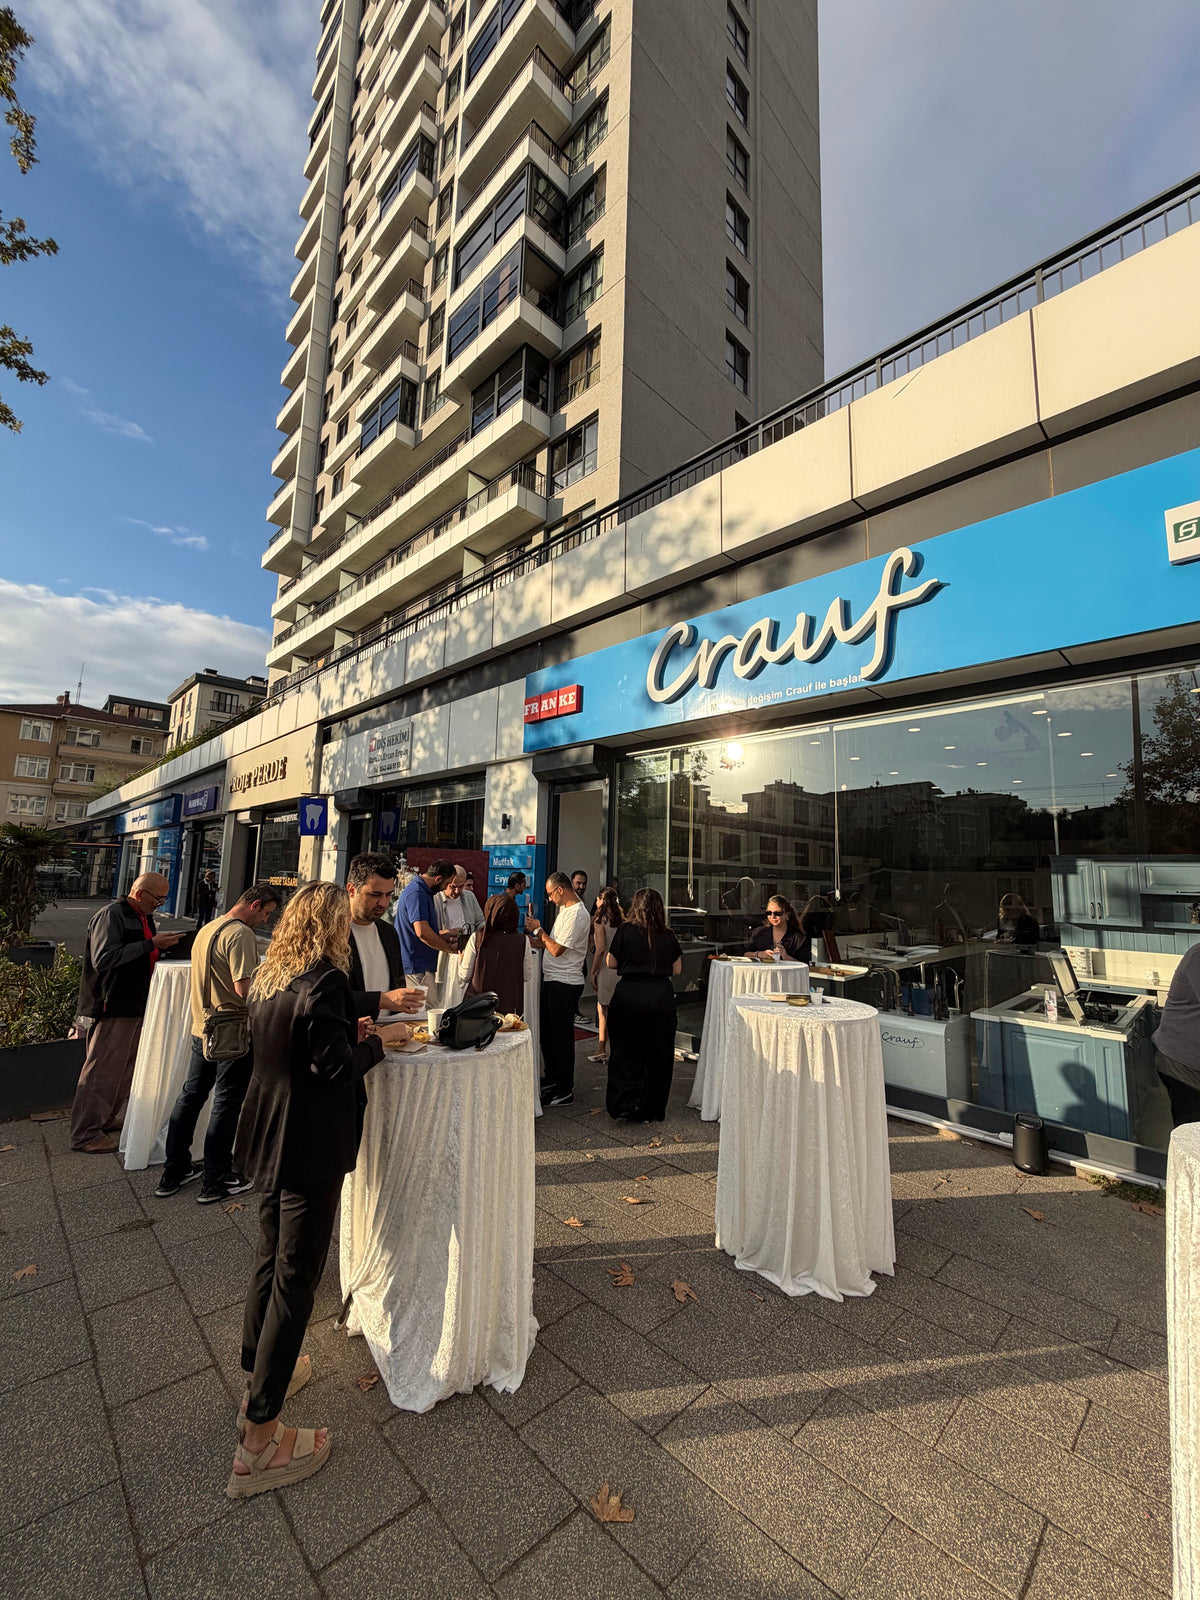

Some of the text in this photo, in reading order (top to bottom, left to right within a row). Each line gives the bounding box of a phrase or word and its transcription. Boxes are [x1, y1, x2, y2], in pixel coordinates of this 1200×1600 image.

[646, 547, 942, 703] Crauf
[785, 682, 813, 697] Crauf
[814, 680, 827, 691] ile
[523, 692, 577, 716] FRANKE
[229, 756, 287, 793] PROJE PERDE
[492, 856, 514, 867] Mutfak
[881, 1031, 919, 1049] Crauf
